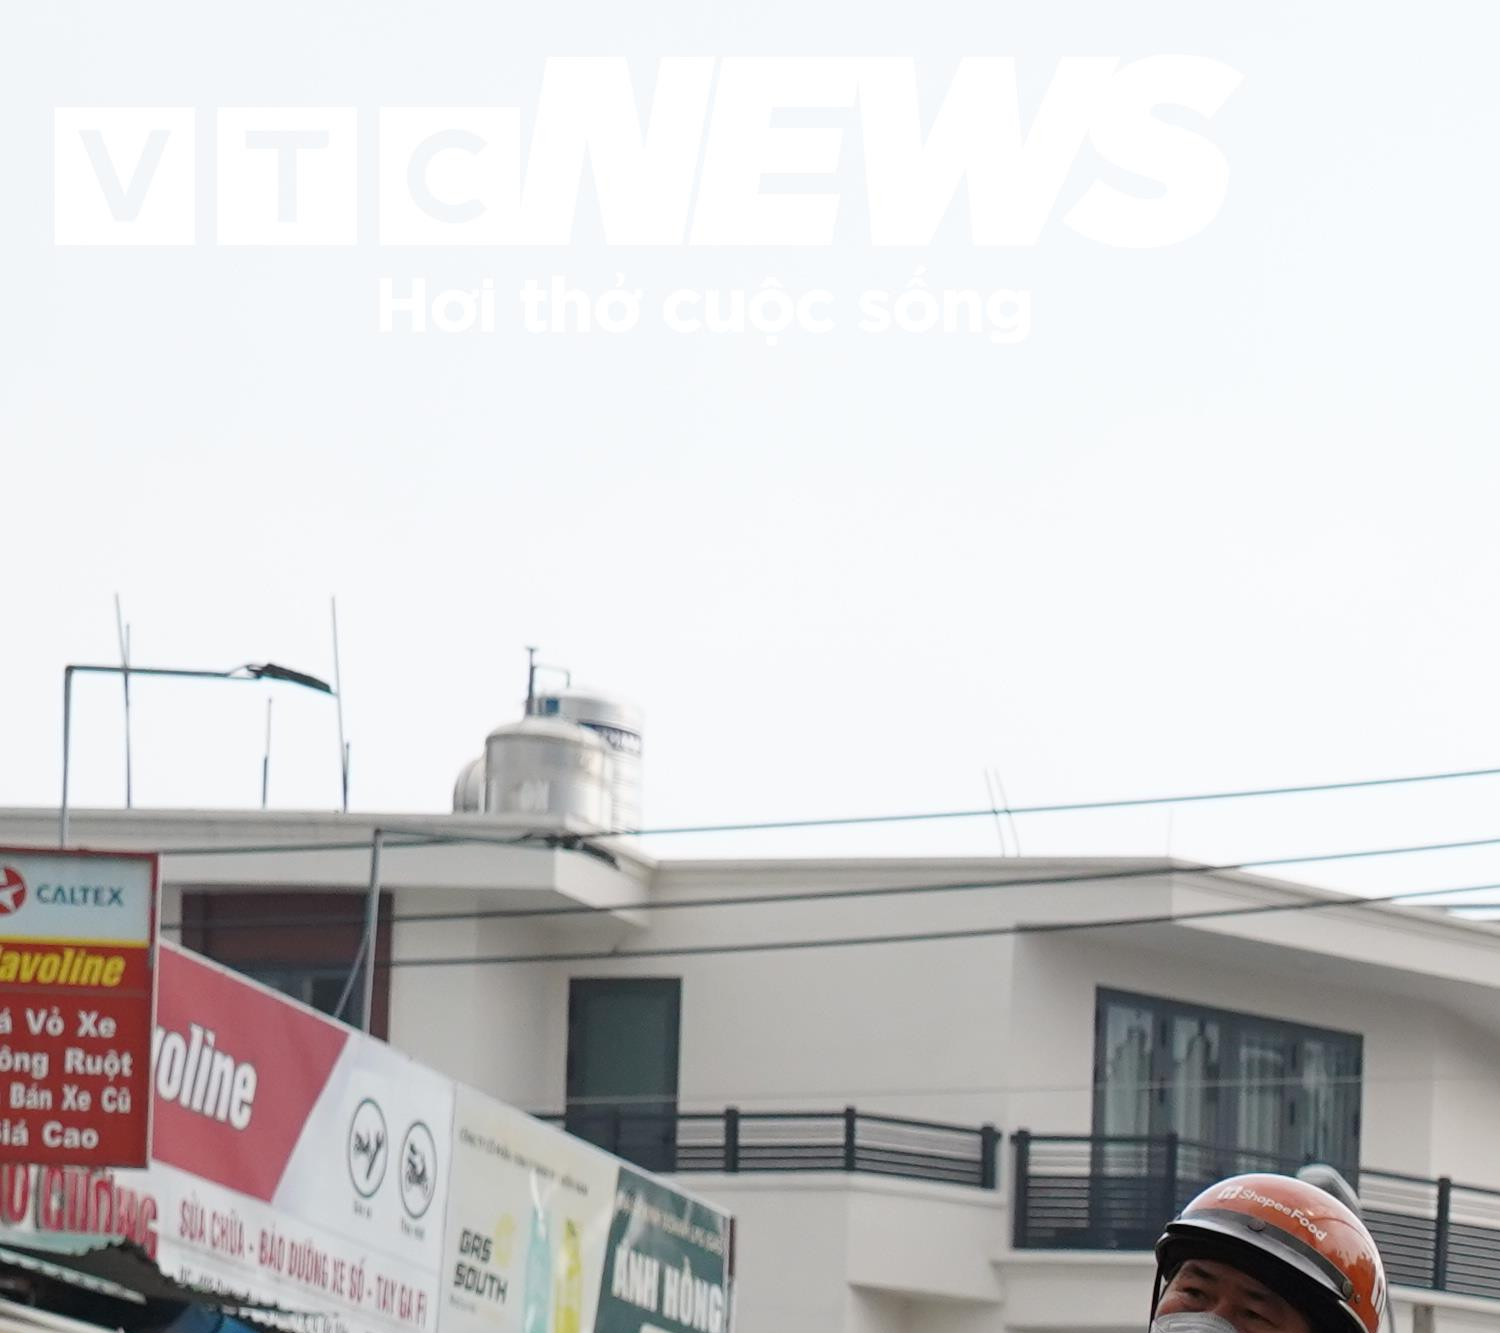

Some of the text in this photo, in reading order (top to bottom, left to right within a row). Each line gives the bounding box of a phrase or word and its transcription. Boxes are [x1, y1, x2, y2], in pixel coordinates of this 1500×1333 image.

[36, 883, 124, 908] CALTEX
[0, 946, 126, 988] avoline
[26, 1006, 65, 1037] Vỏ
[77, 1009, 117, 1039] Xe
[64, 1048, 133, 1083] Ruột
[9, 1082, 54, 1111] Bán
[61, 1083, 92, 1113] Xe
[0, 1120, 100, 1151] iá Cao
[1238, 1189, 1328, 1242] ShopeeFood
[459, 1228, 493, 1264] GAS
[258, 1222, 286, 1273] BẢO
[332, 1258, 345, 1296] XE
[349, 1256, 367, 1303] SỐ
[376, 1275, 398, 1314] TAY
[399, 1285, 413, 1321] GA
[453, 1261, 508, 1304] SOUTH
